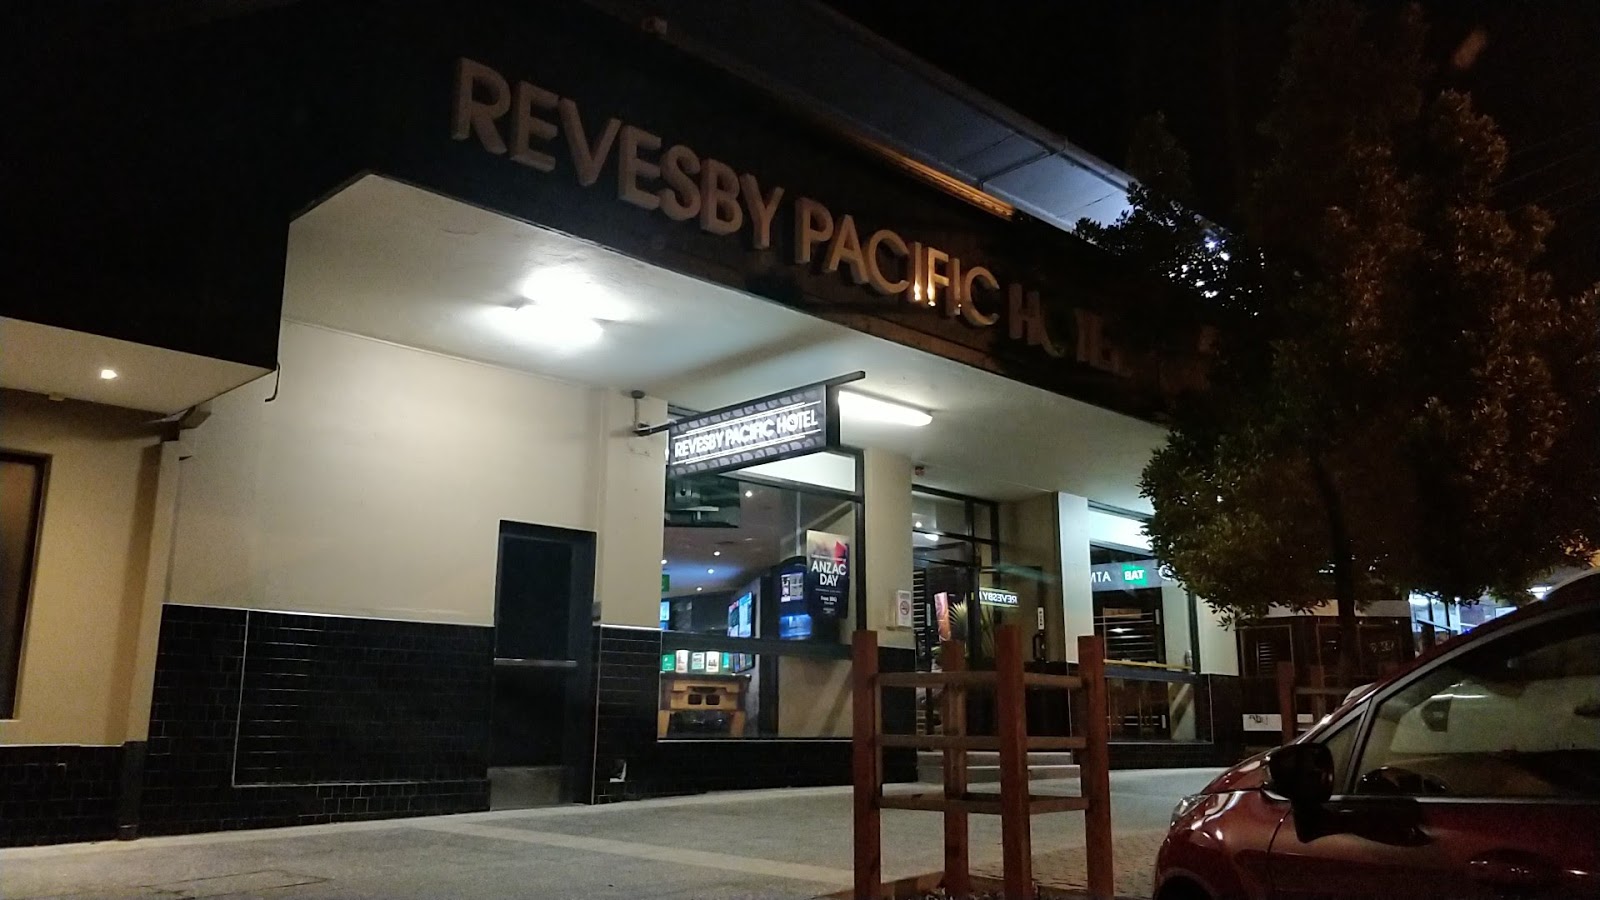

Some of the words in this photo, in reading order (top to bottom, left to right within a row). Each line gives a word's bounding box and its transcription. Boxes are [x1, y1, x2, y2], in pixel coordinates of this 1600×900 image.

[451, 56, 785, 249] REVESBY
[794, 197, 1000, 327] PACIFIC
[674, 430, 725, 458] REVESBY
[725, 419, 776, 447] PACIFIC
[776, 409, 819, 434] HOTEL
[811, 560, 847, 576] ANZAC
[820, 573, 839, 587] DAY
